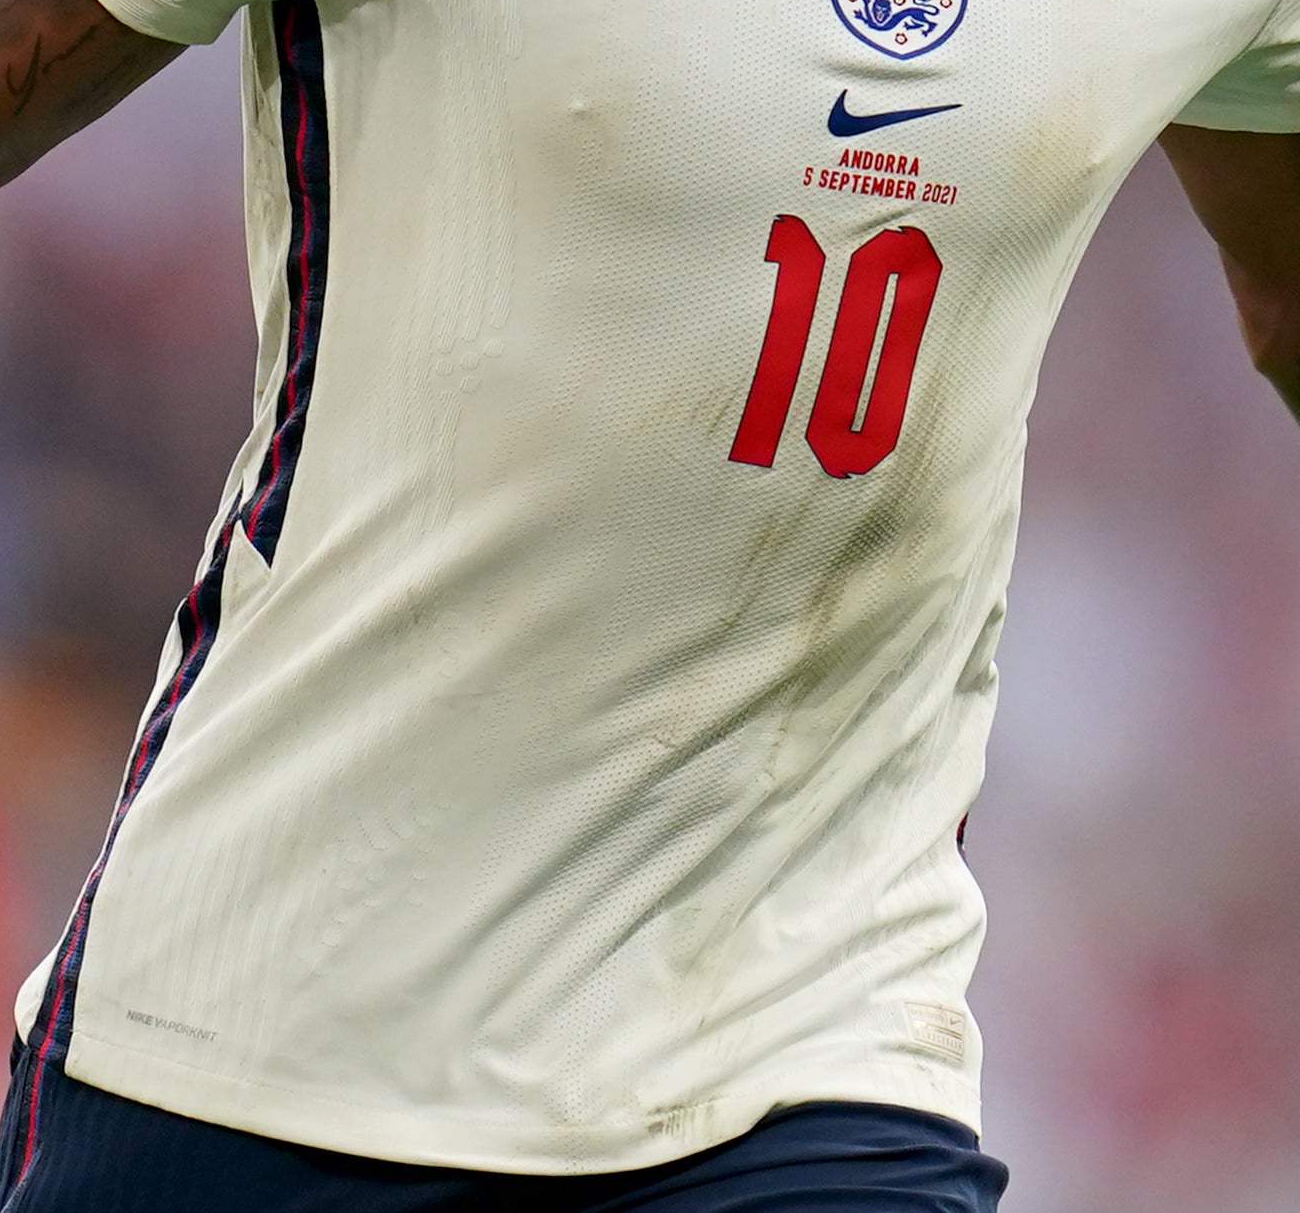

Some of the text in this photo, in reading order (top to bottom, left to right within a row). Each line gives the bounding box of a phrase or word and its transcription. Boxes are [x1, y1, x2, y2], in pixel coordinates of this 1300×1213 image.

[838, 148, 920, 176] ANDORRA
[802, 167, 958, 205] 5 SEPTEMBER 2021
[728, 213, 943, 479] 10
[126, 1009, 154, 1026] NIKE
